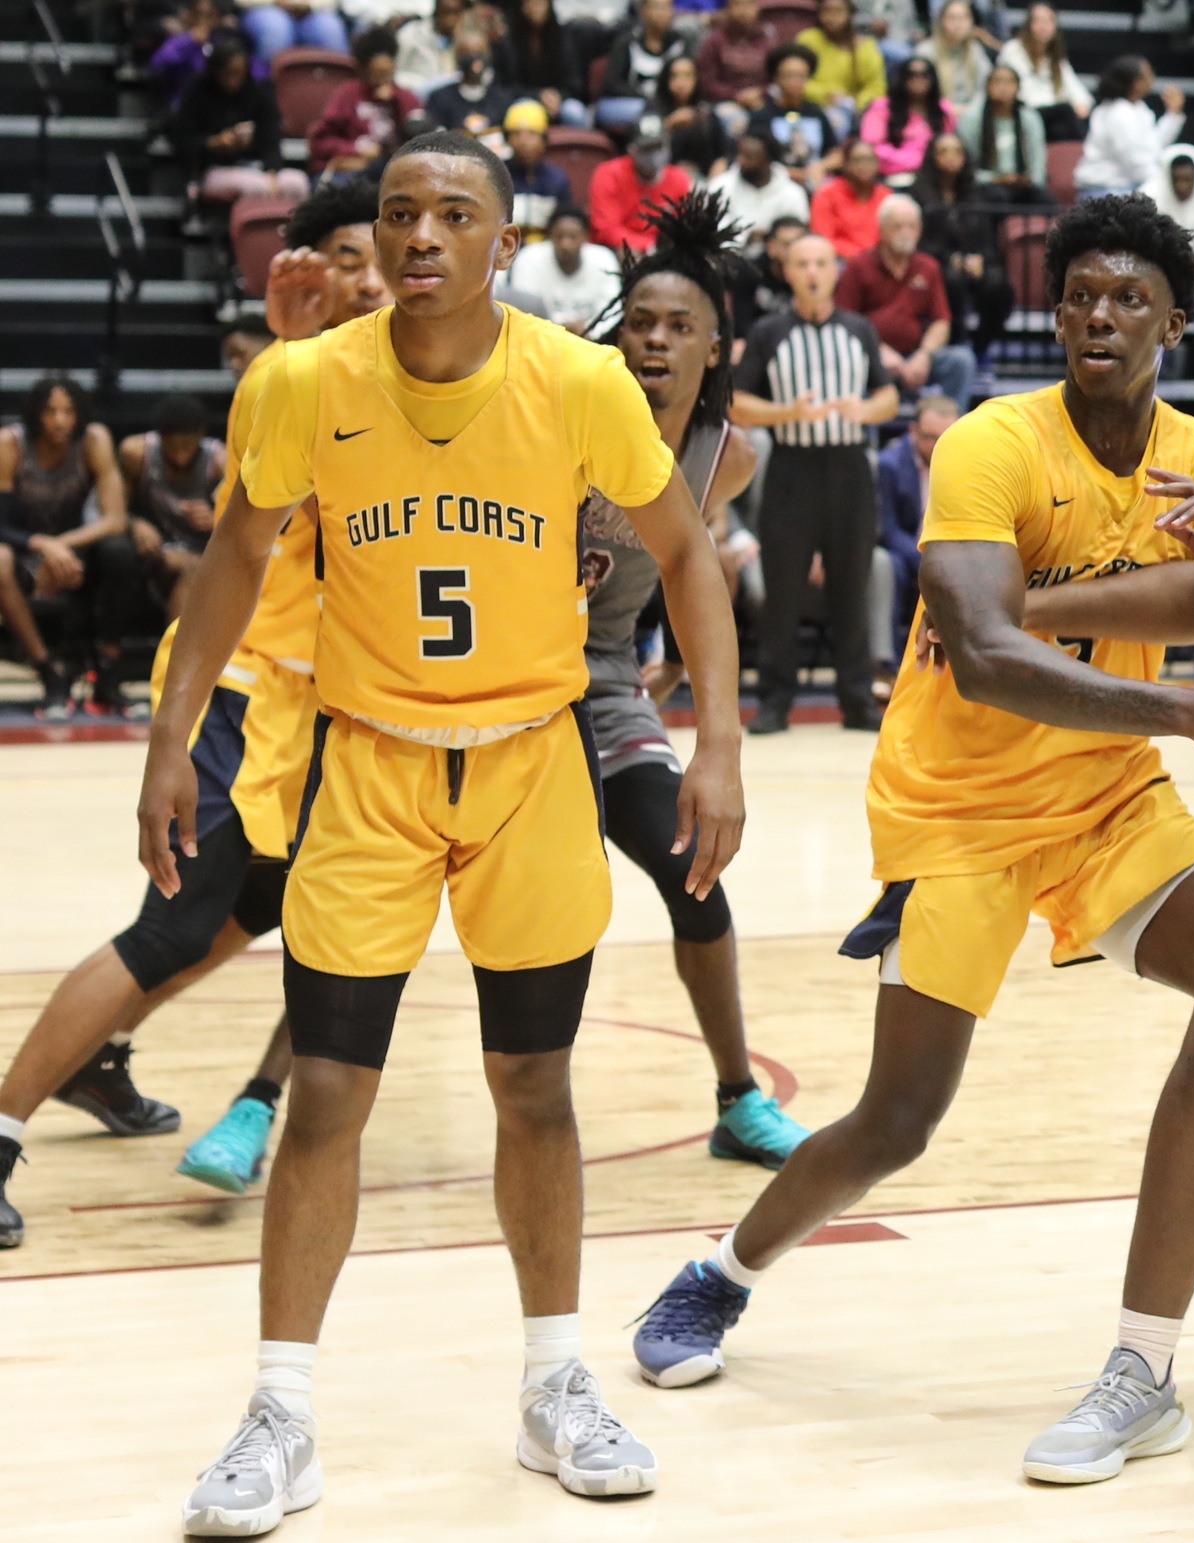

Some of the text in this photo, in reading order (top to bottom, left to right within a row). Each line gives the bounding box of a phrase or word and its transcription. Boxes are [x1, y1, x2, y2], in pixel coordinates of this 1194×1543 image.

[346, 496, 422, 548] GULF
[436, 494, 546, 551] COAST
[415, 565, 478, 661] 5
